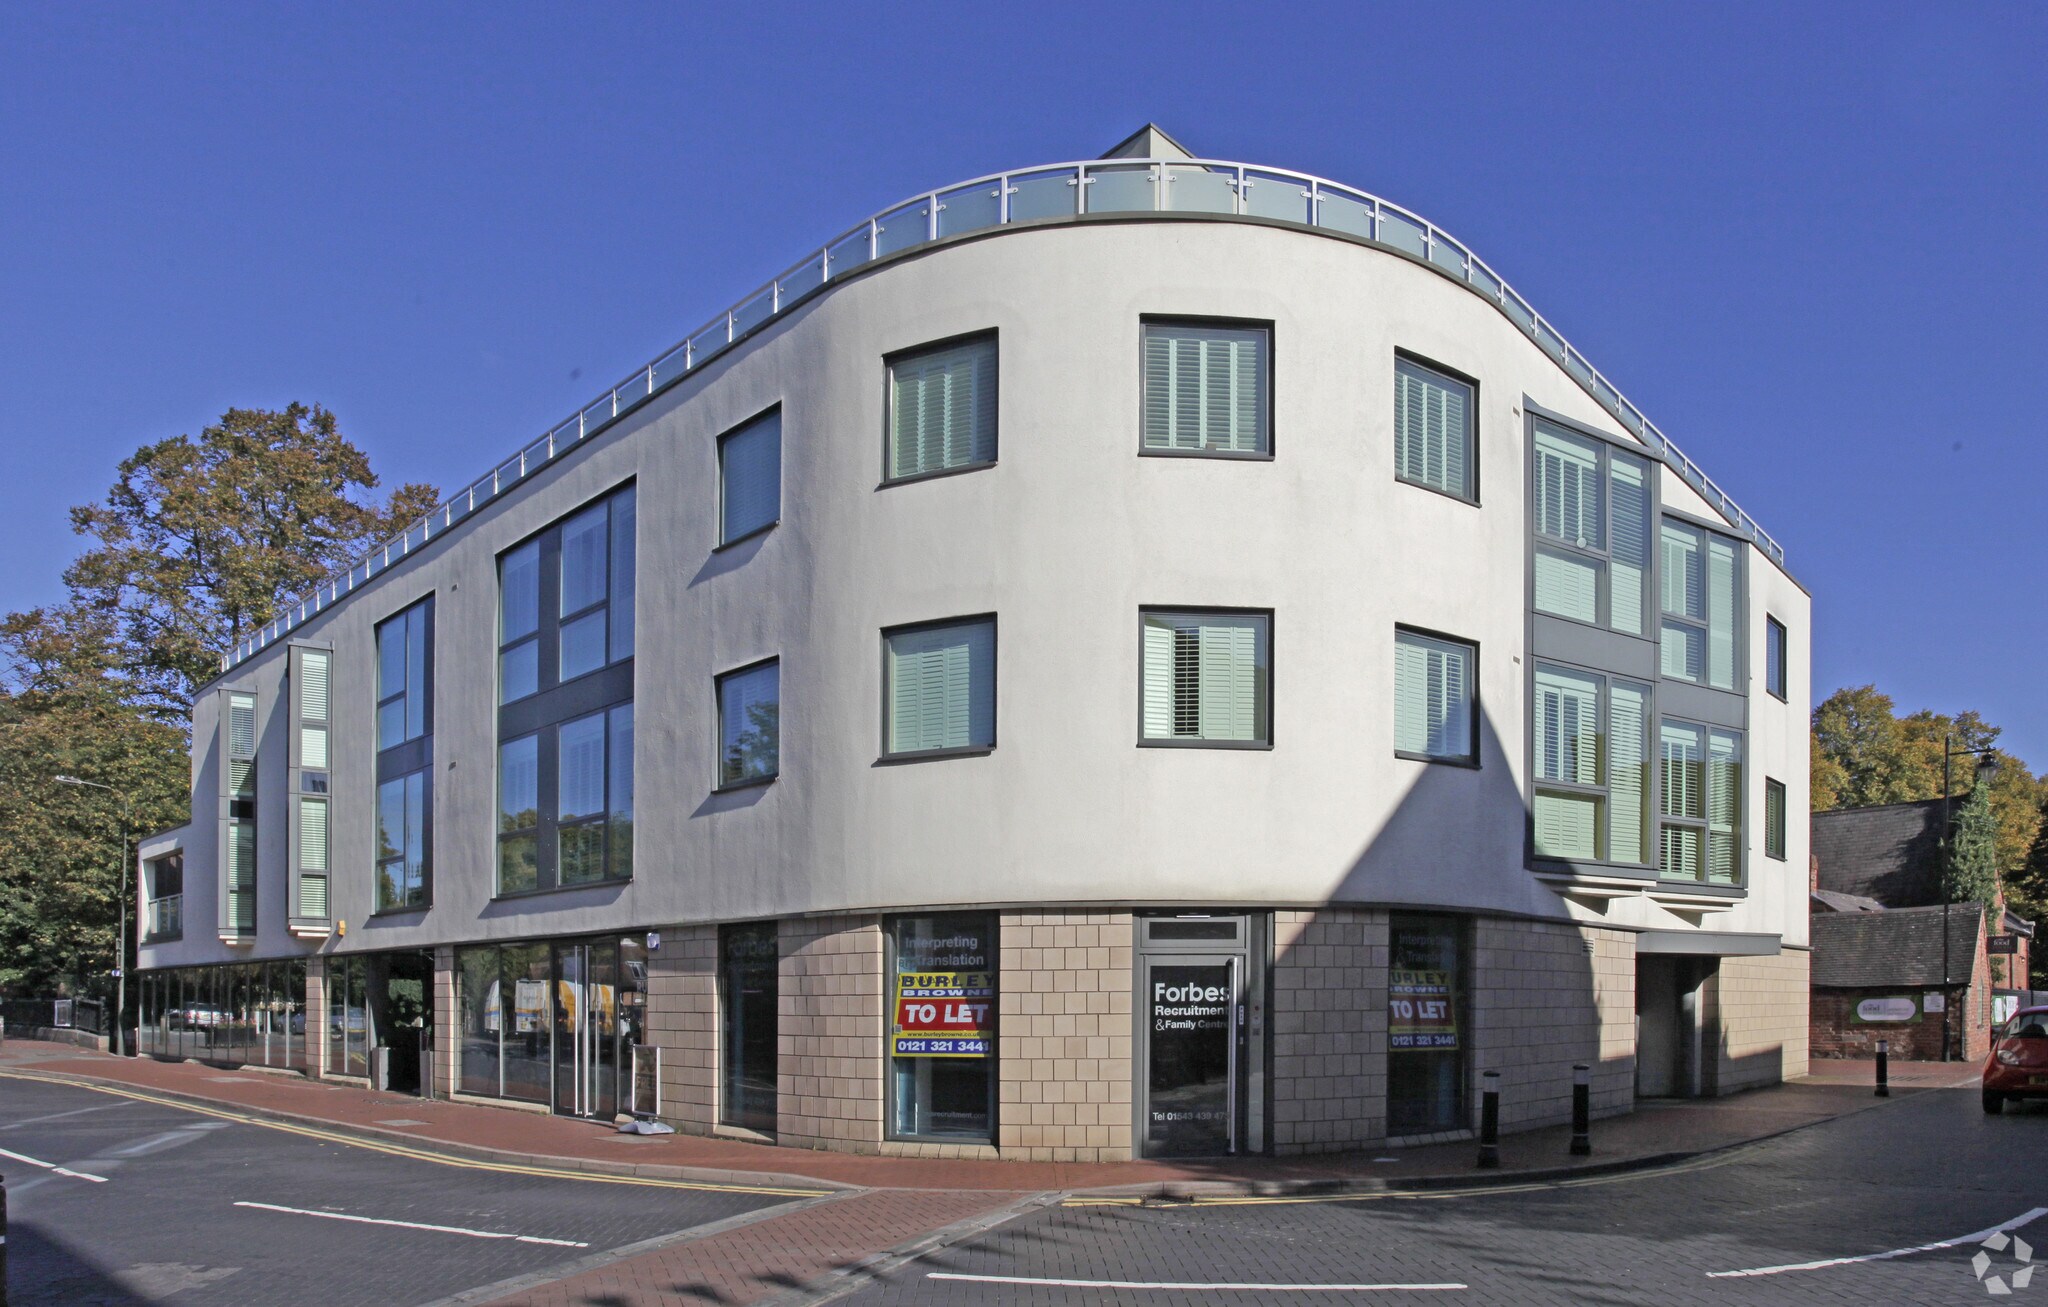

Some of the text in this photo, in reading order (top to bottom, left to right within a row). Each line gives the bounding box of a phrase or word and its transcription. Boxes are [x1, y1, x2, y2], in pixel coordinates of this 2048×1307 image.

[905, 935, 978, 950] Interpreting
[918, 953, 984, 966] Translation
[901, 974, 993, 988] BURLEY
[1391, 971, 1447, 984] URLEY
[1155, 982, 1229, 1002] Forbes
[905, 1004, 988, 1023] TO LET
[1390, 1000, 1447, 1019] TO LET
[1155, 1018, 1165, 1031] &
[1165, 1020, 1196, 1030] Family
[898, 1041, 989, 1051] 0121 321 3441
[1392, 1035, 1455, 1046] 0121 321 3441
[1152, 1112, 1165, 1120] Tel
